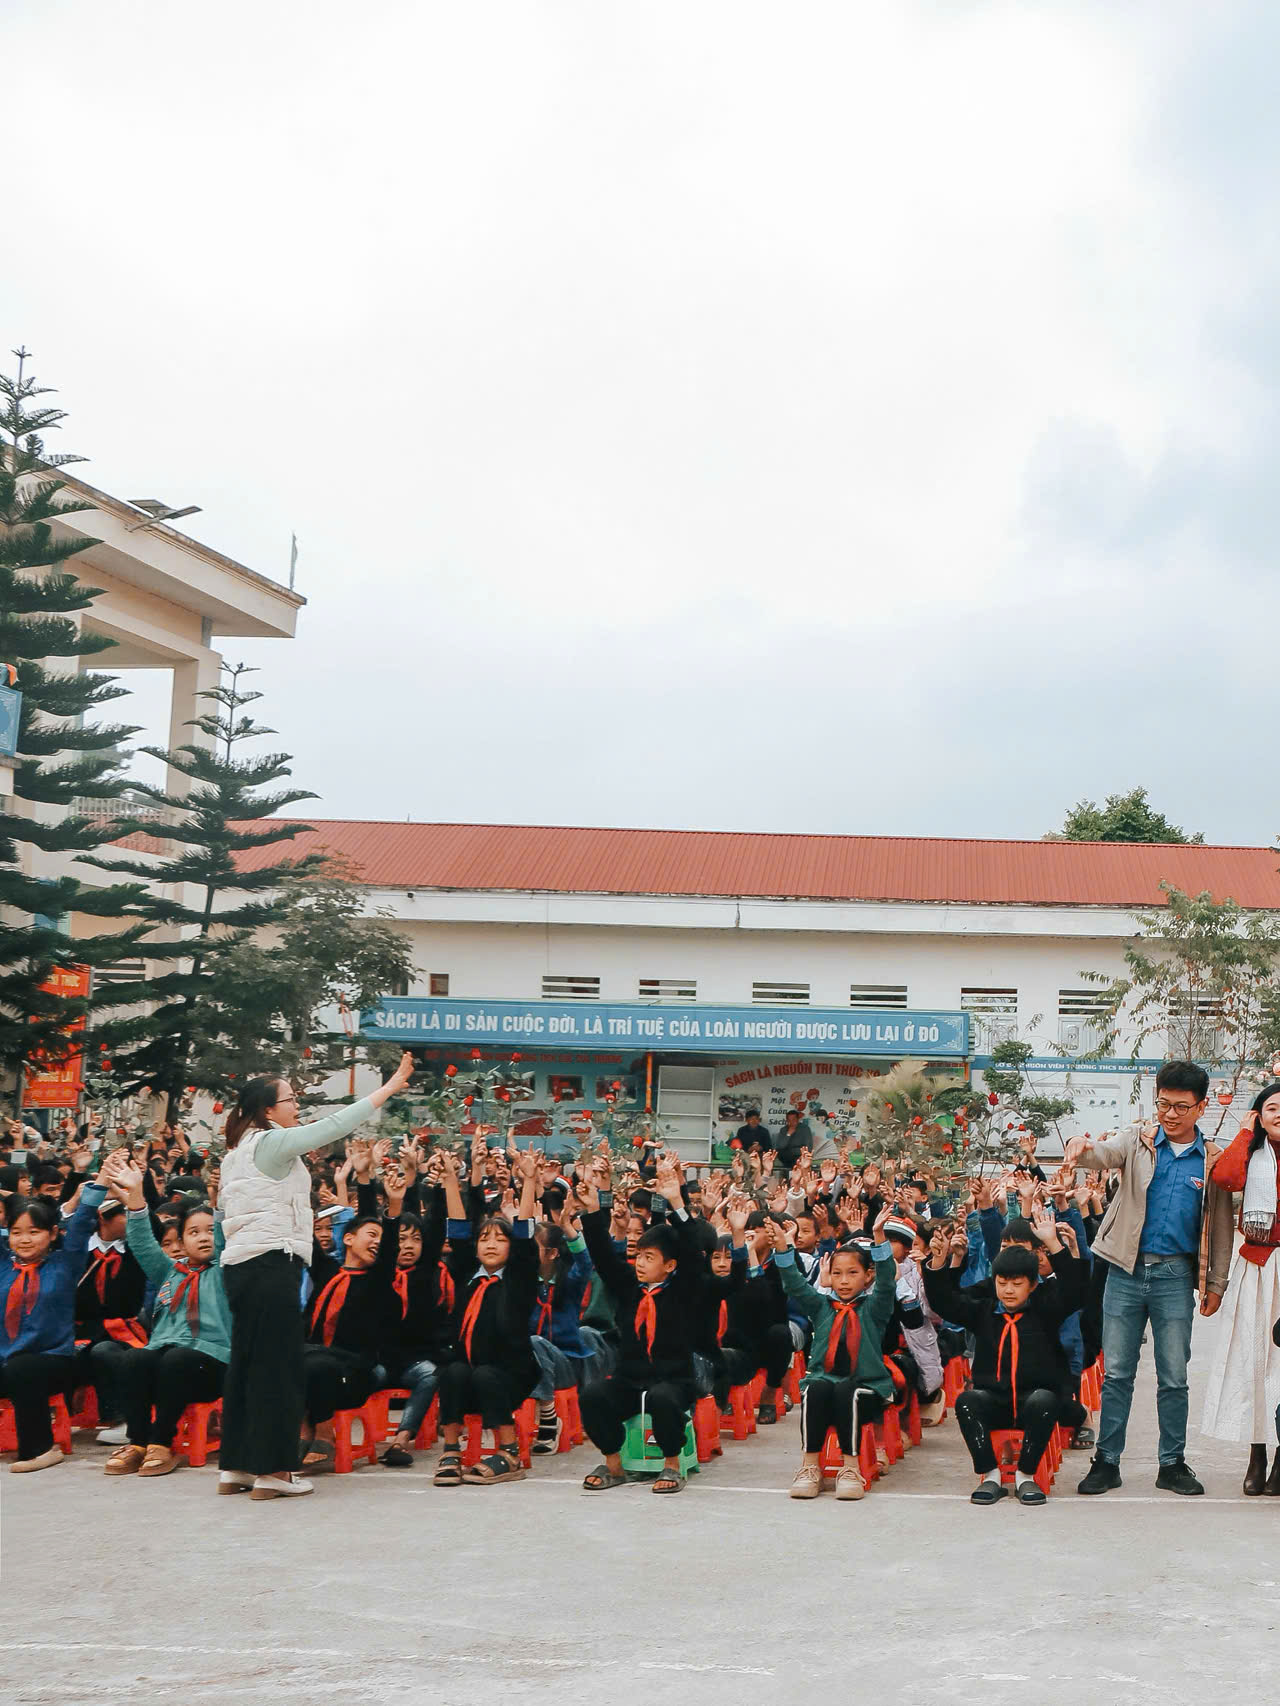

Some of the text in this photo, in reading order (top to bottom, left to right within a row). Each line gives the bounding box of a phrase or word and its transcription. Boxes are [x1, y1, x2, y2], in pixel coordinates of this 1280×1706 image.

[375, 1009, 940, 1045] SÁCH LÀ DI SẢN CUỘC ĐỜI, LÀ TRÍ TUỆ CỦA LOÀI NGƯỜI ĐƯỢC LƯU LẠI Ở ĐÓ
[815, 1062, 833, 1075] TRI
